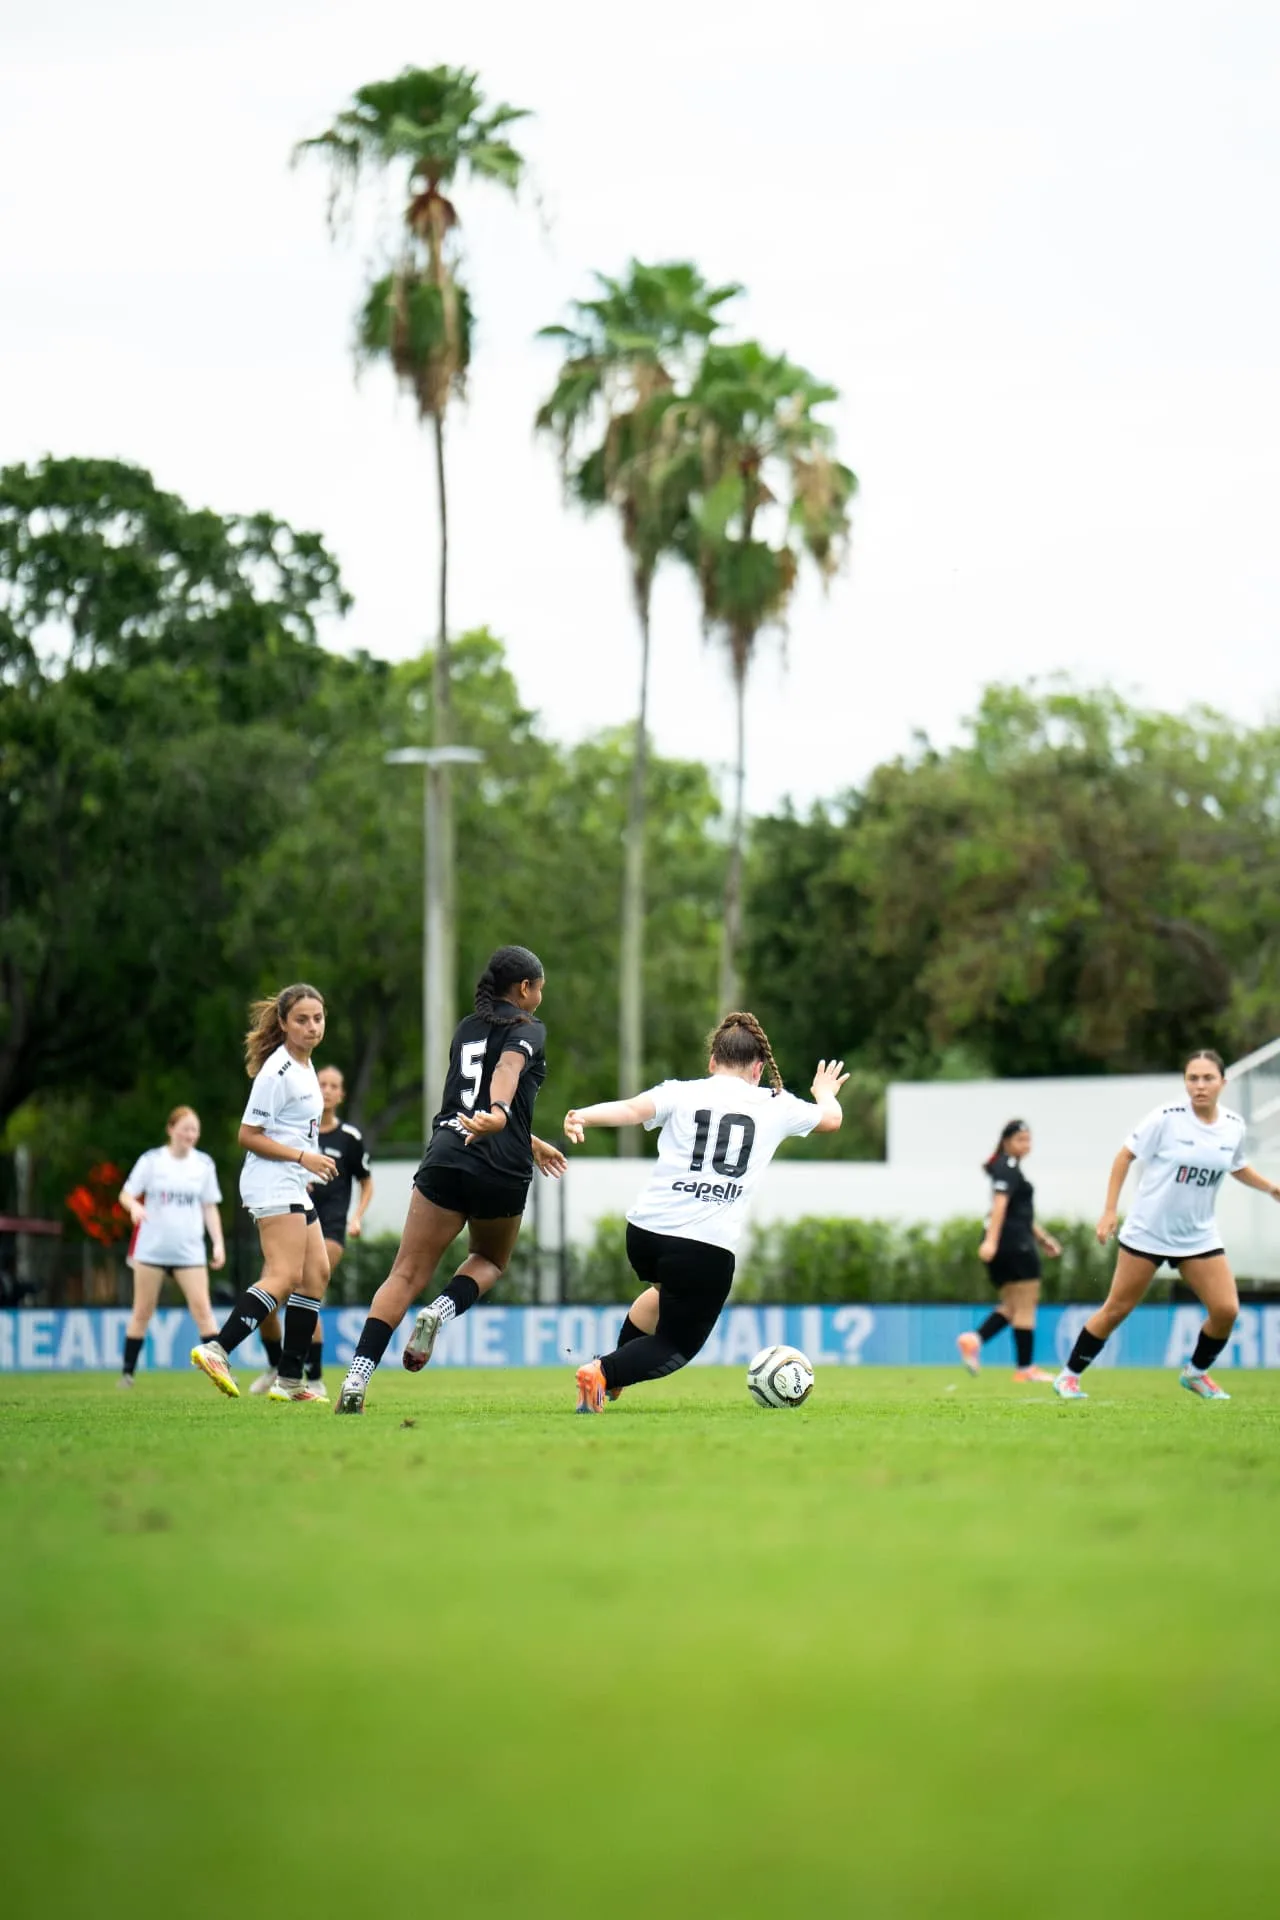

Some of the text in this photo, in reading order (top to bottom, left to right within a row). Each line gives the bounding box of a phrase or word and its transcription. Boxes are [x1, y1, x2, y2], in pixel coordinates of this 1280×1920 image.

[461, 1038, 487, 1110] 5
[690, 1109, 755, 1178] 10
[672, 1181, 743, 1200] capelli
